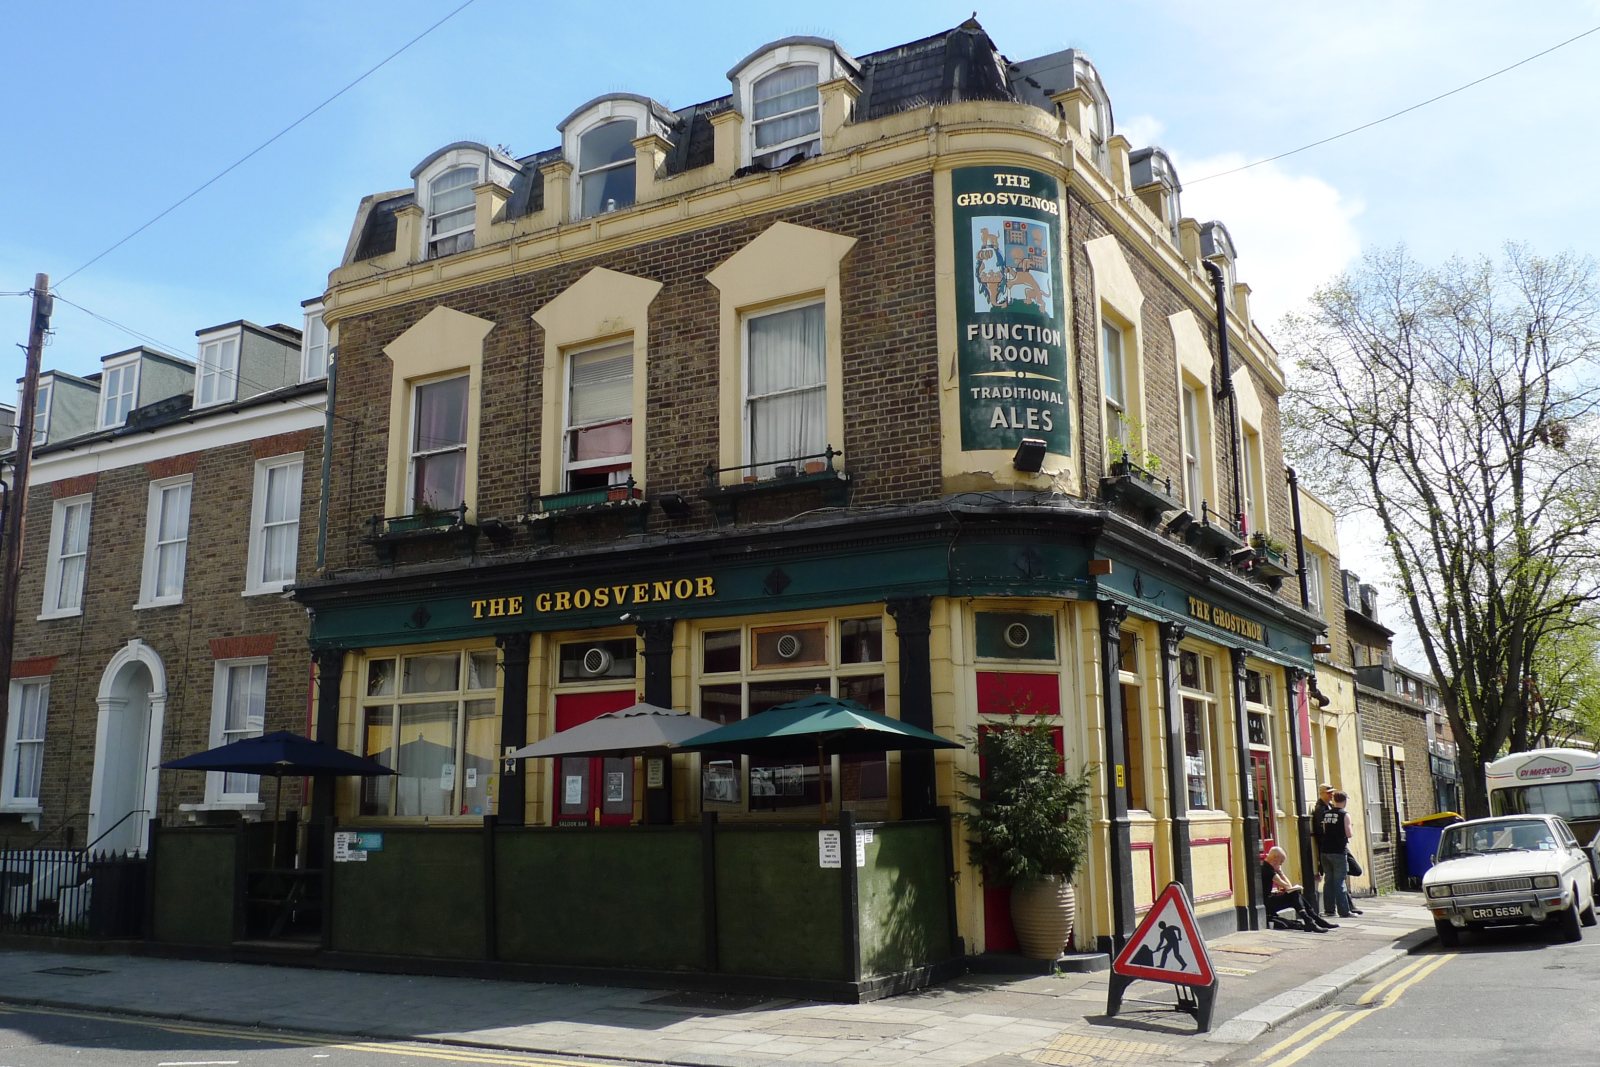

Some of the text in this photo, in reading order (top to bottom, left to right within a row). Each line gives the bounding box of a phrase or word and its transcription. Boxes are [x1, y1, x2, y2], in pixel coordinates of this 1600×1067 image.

[994, 173, 1031, 189] THE
[957, 192, 1059, 215] GROSVENOR
[967, 323, 1061, 347] FUNCTION
[990, 345, 1049, 365] ROOM
[971, 387, 1064, 405] TRADITIONAL
[990, 406, 1053, 432] ALES
[471, 576, 716, 619] THE GROSVENOR
[1189, 597, 1262, 641] THE GROSVENOR
[1520, 769, 1529, 777] DI
[1472, 906, 1523, 919] CRD 669K
